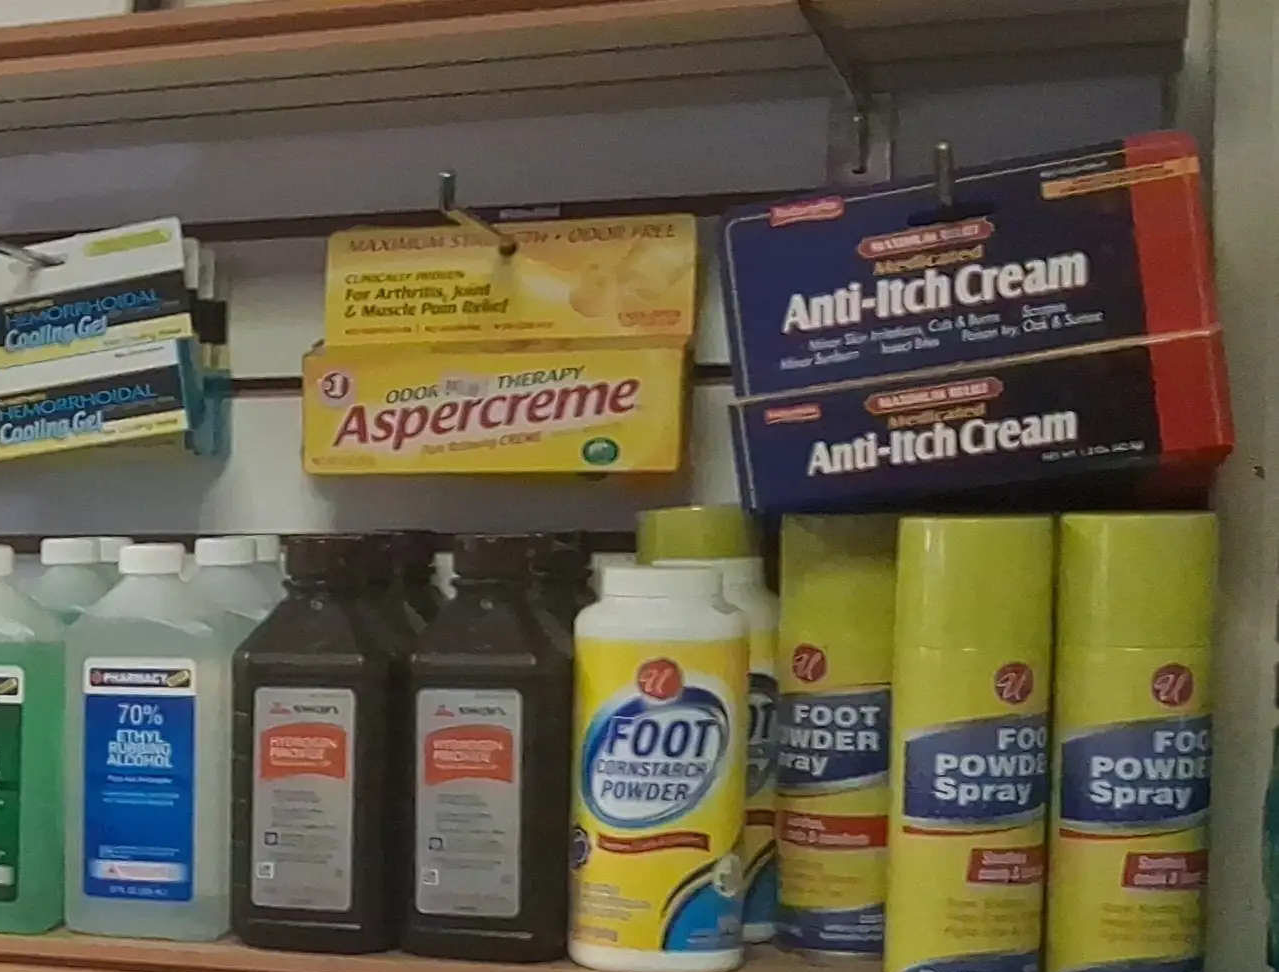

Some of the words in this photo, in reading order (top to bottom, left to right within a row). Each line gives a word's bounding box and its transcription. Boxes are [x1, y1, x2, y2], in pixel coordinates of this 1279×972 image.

[631, 223, 675, 239] FREE
[345, 287, 371, 301] For
[374, 285, 448, 301] Arthritis,
[451, 282, 491, 299] Joint
[782, 271, 952, 334] Anti-Itch
[954, 251, 1089, 305] Cream
[4, 289, 160, 329] HEMORRHOIDAL
[361, 303, 417, 318] Muscle
[419, 301, 457, 316] Pain
[461, 297, 509, 314] Relief
[4, 322, 75, 353] Cooling
[76, 314, 108, 340] Gel
[497, 365, 586, 390] THERAPY
[386, 385, 438, 405] ODOR
[71, 410, 104, 433] Gel
[333, 377, 641, 450] Aspercreme
[807, 422, 958, 476] Anti-Itch
[960, 411, 1078, 456] Cream
[116, 703, 164, 727] 70%
[793, 704, 881, 728] FOOT
[115, 729, 163, 745] ETHYL
[605, 718, 720, 761] FOOT
[997, 728, 1048, 752] FOO
[1152, 731, 1208, 754] FOO
[106, 753, 173, 770] ALCOHOL
[108, 741, 172, 758] RUBBING
[596, 759, 709, 778] CORNSTARCH
[935, 753, 1047, 778] POWDE
[1091, 757, 1210, 781] POWDE
[600, 779, 691, 802] POWDER
[933, 777, 1032, 807] Spray
[1090, 780, 1193, 811] Spray
